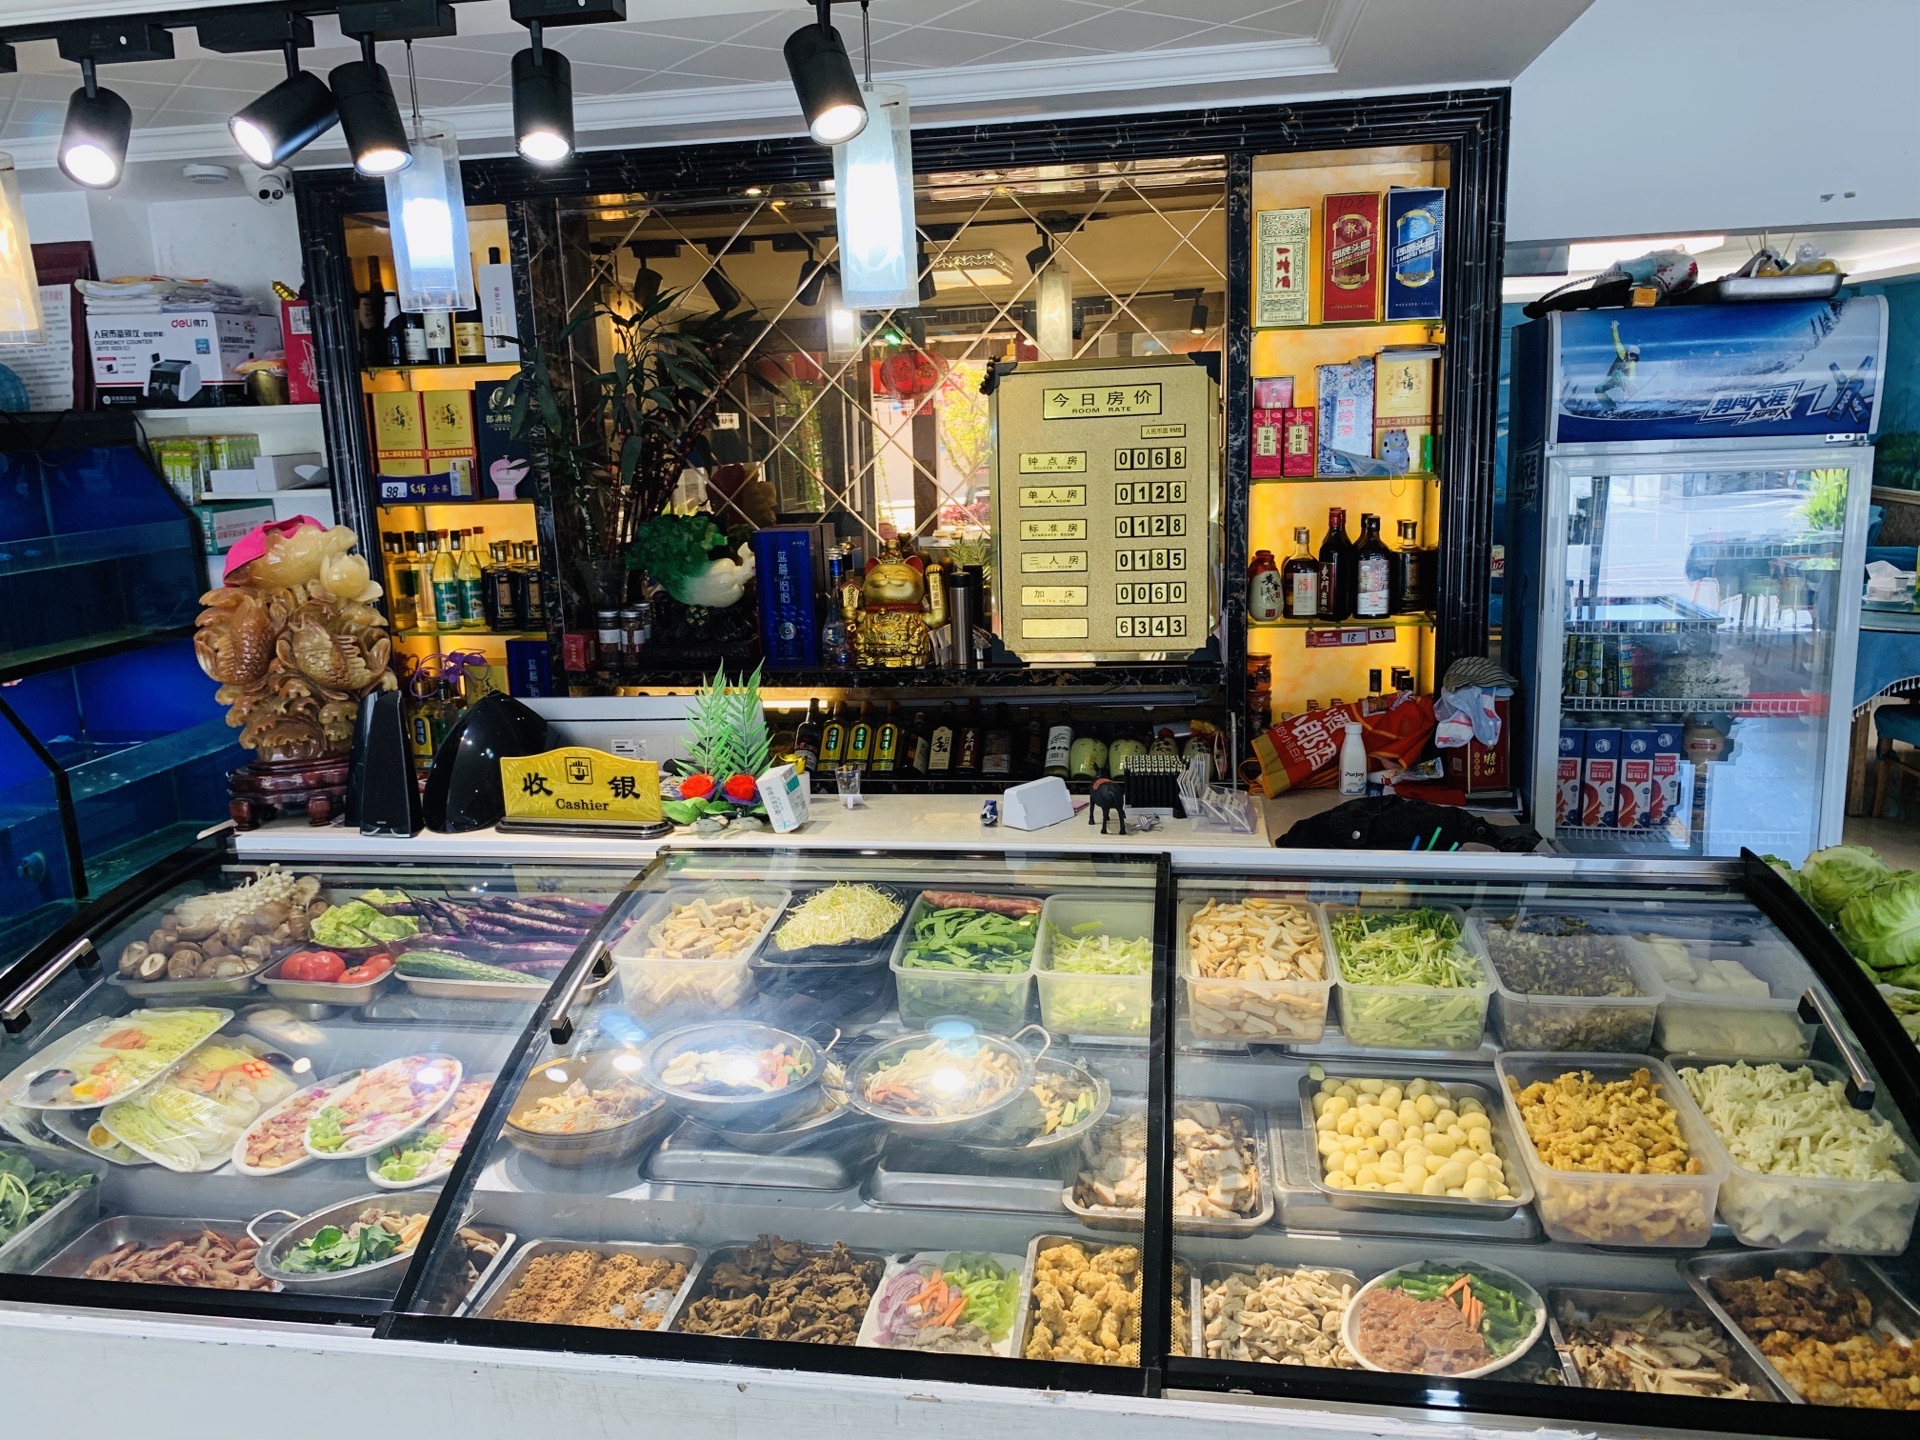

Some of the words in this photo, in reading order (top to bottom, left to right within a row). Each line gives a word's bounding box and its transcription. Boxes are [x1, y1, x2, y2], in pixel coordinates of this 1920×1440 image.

[171, 319, 192, 328] deli
[1052, 389, 1153, 408] 今日房价
[1712, 389, 1789, 413] 勇闯天涯
[1028, 456, 1078, 466] 钟点房
[1119, 450, 1182, 465] 0068
[386, 486, 399, 498] 98
[1028, 489, 1078, 499] 单人房
[1119, 484, 1182, 501] 0128
[1028, 523, 1078, 533] 标准房
[1119, 518, 1182, 534] 0128
[1029, 555, 1079, 565] 三人房
[1119, 552, 1182, 567] 0185
[1034, 590, 1075, 599] 加床
[1120, 585, 1182, 601] 0060
[1120, 619, 1182, 634] 6343
[522, 772, 641, 799] 收银
[556, 798, 610, 811] Cashier
